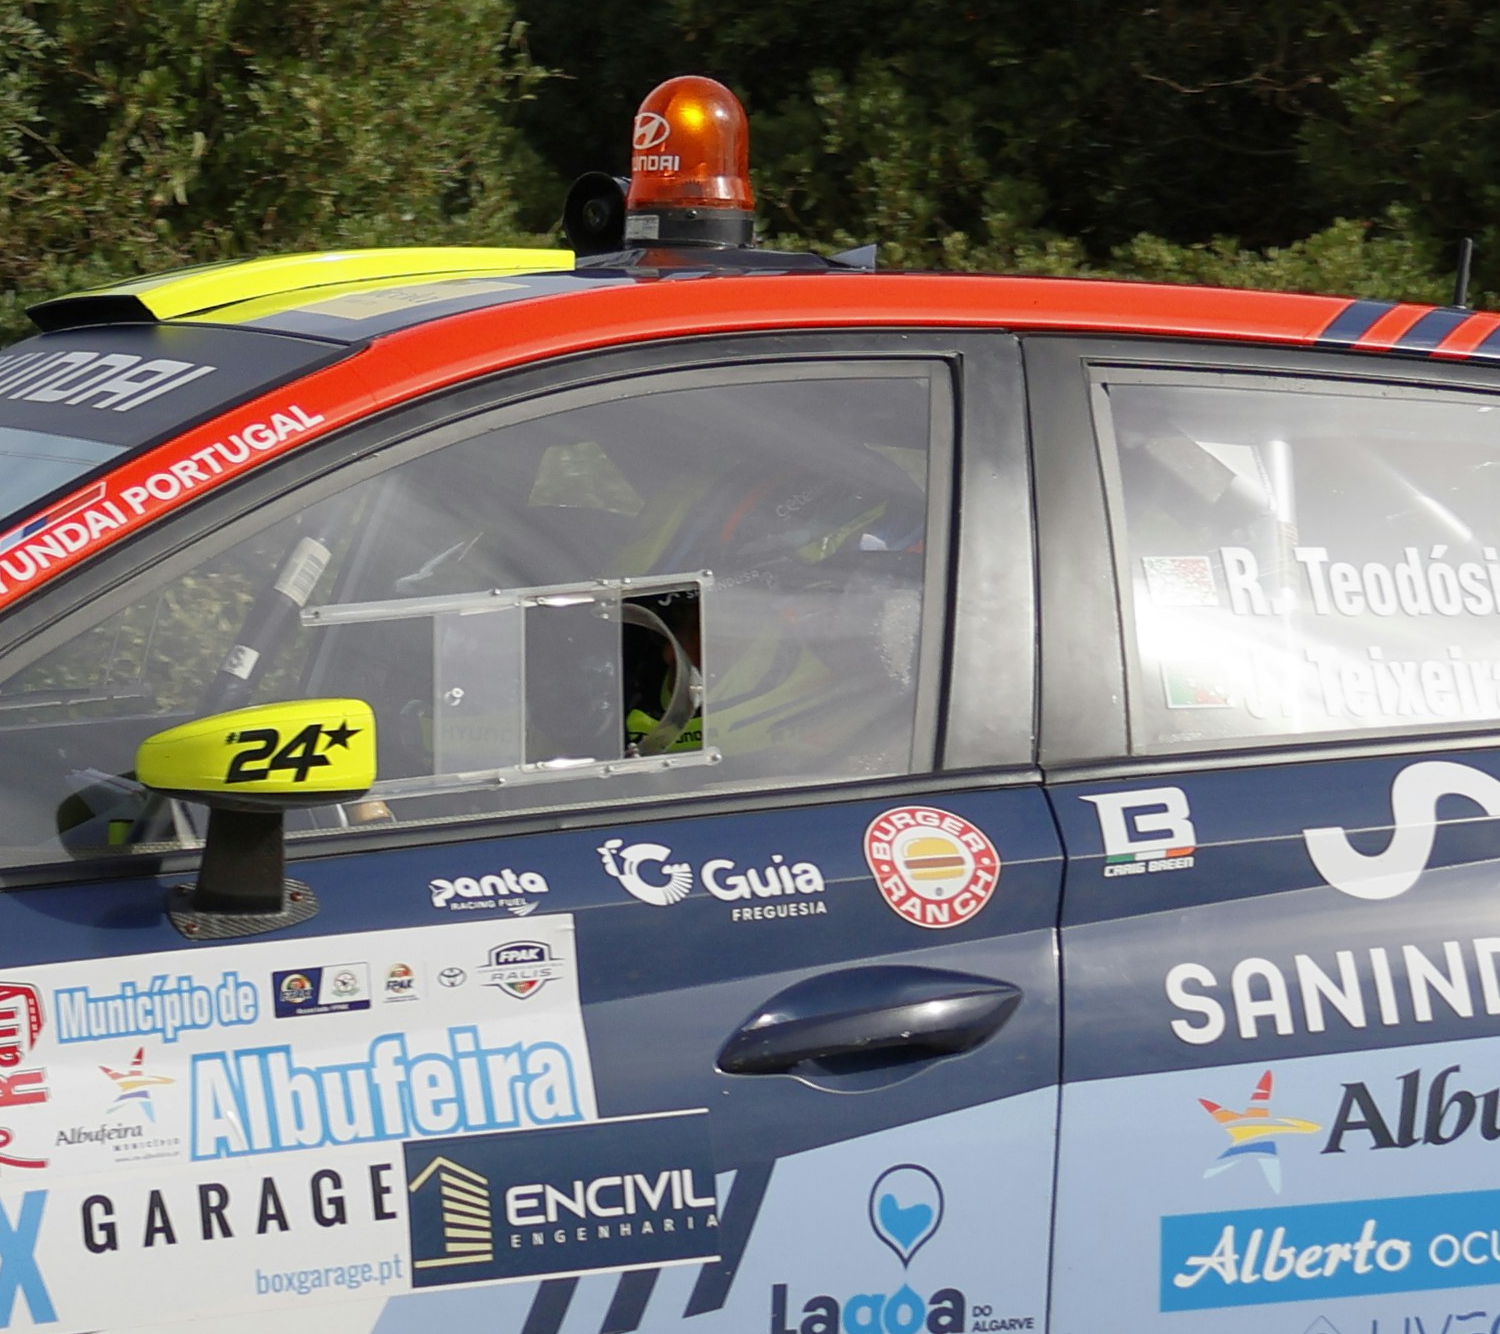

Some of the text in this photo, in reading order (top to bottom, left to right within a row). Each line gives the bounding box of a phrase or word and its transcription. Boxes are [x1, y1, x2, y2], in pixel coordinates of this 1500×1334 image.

[120, 405, 326, 515] PORTUGAL
[1221, 547, 1284, 616] R.
[871, 811, 986, 861] BURGER
[701, 854, 826, 902] Guia
[1148, 857, 1194, 872] BREEN
[428, 868, 550, 908] panta
[450, 897, 528, 911] RACING FUEL
[882, 869, 994, 924] RANCH
[732, 900, 827, 922] FREGUESIA
[491, 968, 553, 981] RALIS
[56, 971, 258, 1043] Município de
[190, 1025, 586, 1162] Albufeira
[55, 1123, 144, 1147] Albufeira
[81, 1163, 397, 1254] GARAGE
[506, 1169, 716, 1226] ENCIVIL
[510, 1214, 719, 1249] ENGENHARIA
[1174, 1218, 1411, 1288] Alberto
[256, 1254, 404, 1295] boxgarage.pt
[972, 1305, 992, 1317] DO
[972, 1317, 1034, 1332] ALGARVE
